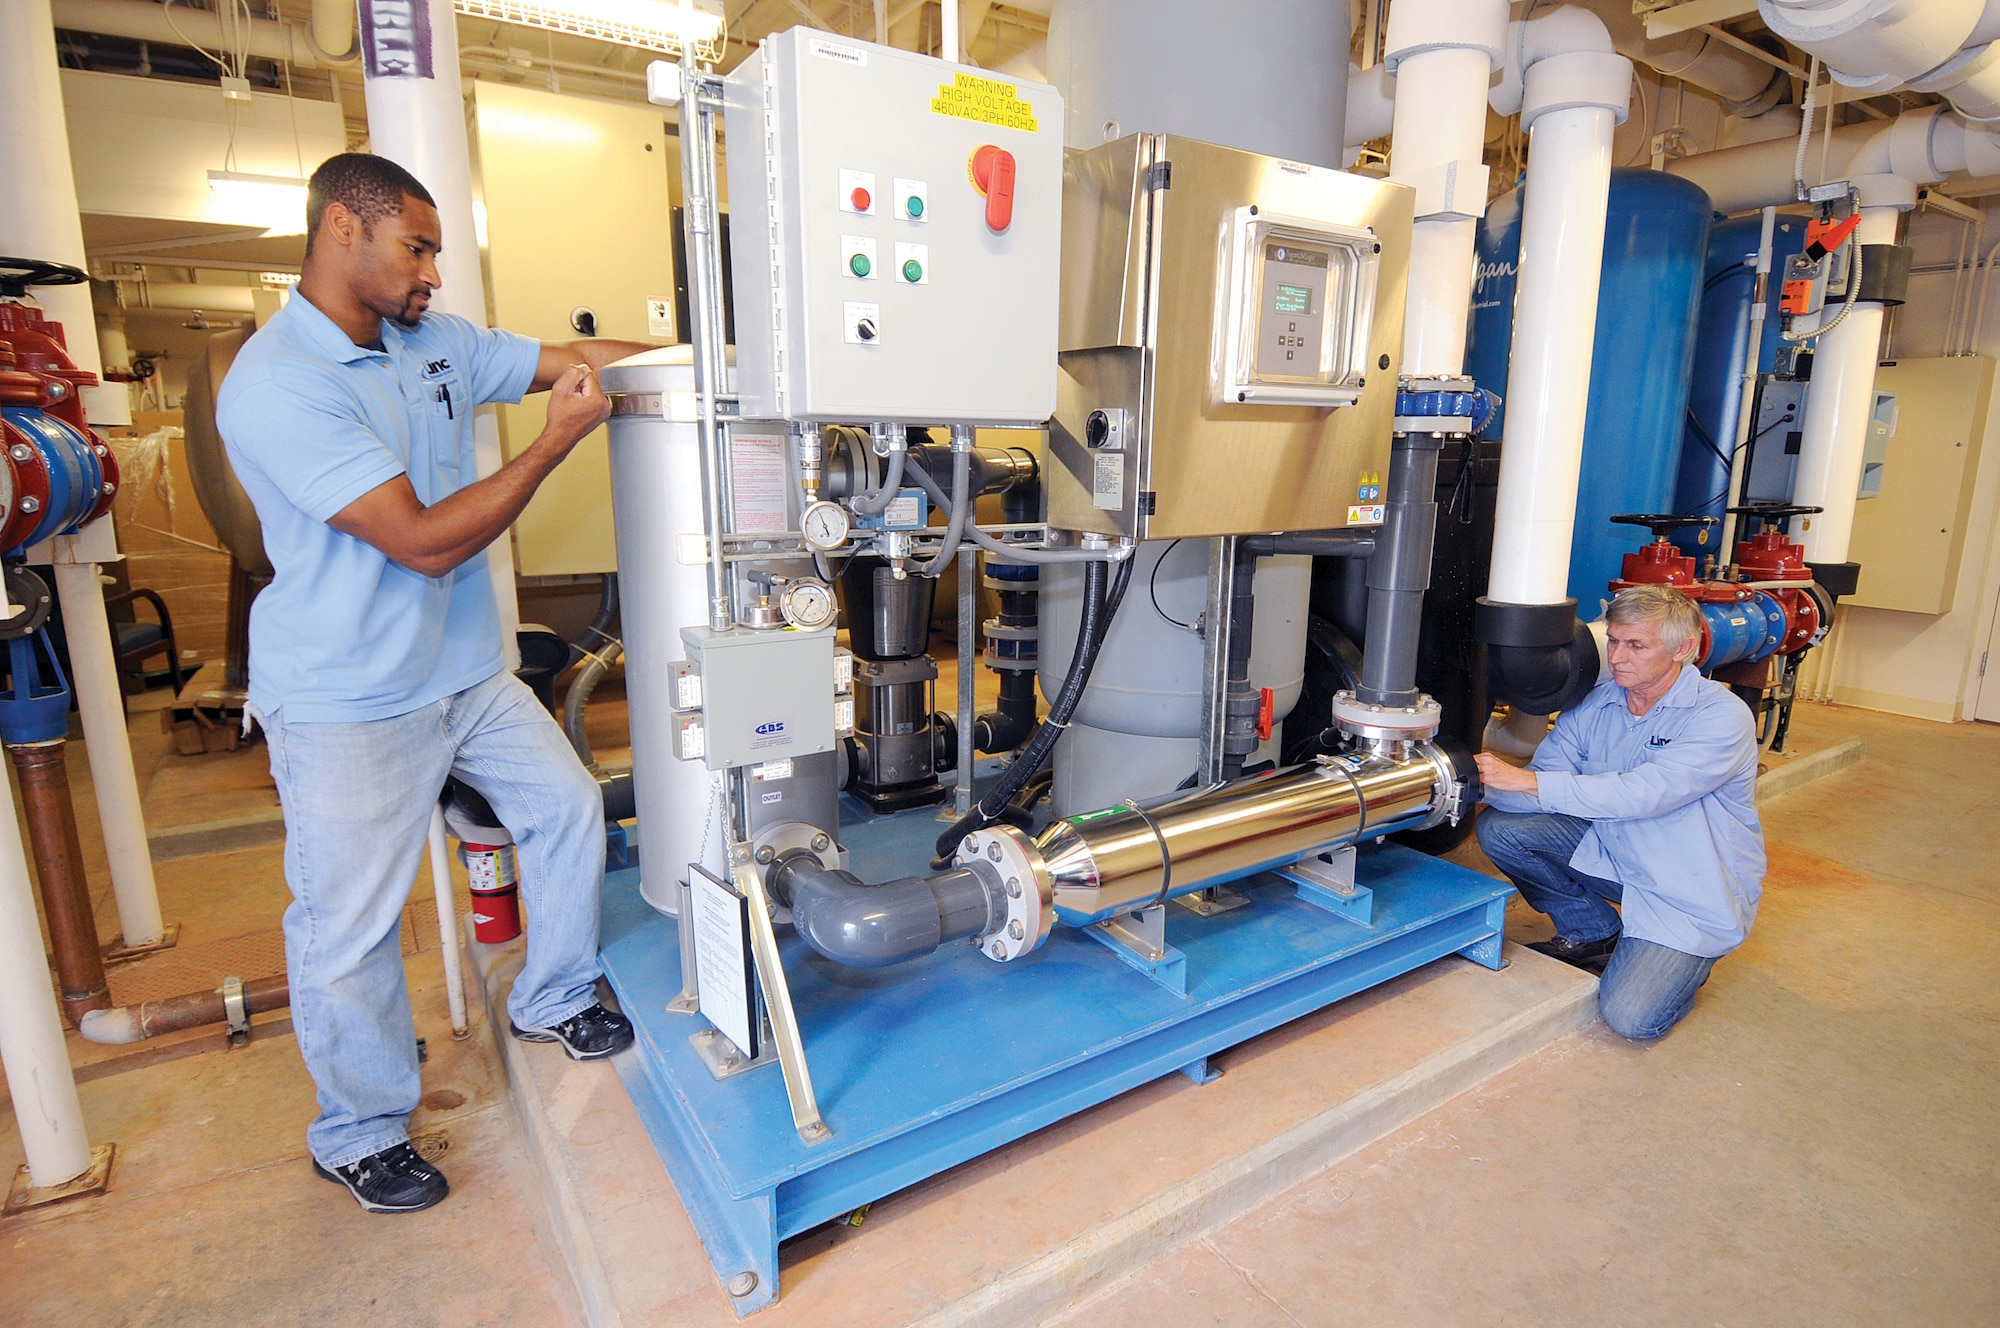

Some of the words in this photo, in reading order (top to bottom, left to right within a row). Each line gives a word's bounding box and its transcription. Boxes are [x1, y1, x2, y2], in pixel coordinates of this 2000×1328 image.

[957, 75, 1013, 98] WARNING
[942, 87, 972, 104] HIGH
[975, 93, 1028, 116] VOLTAGE
